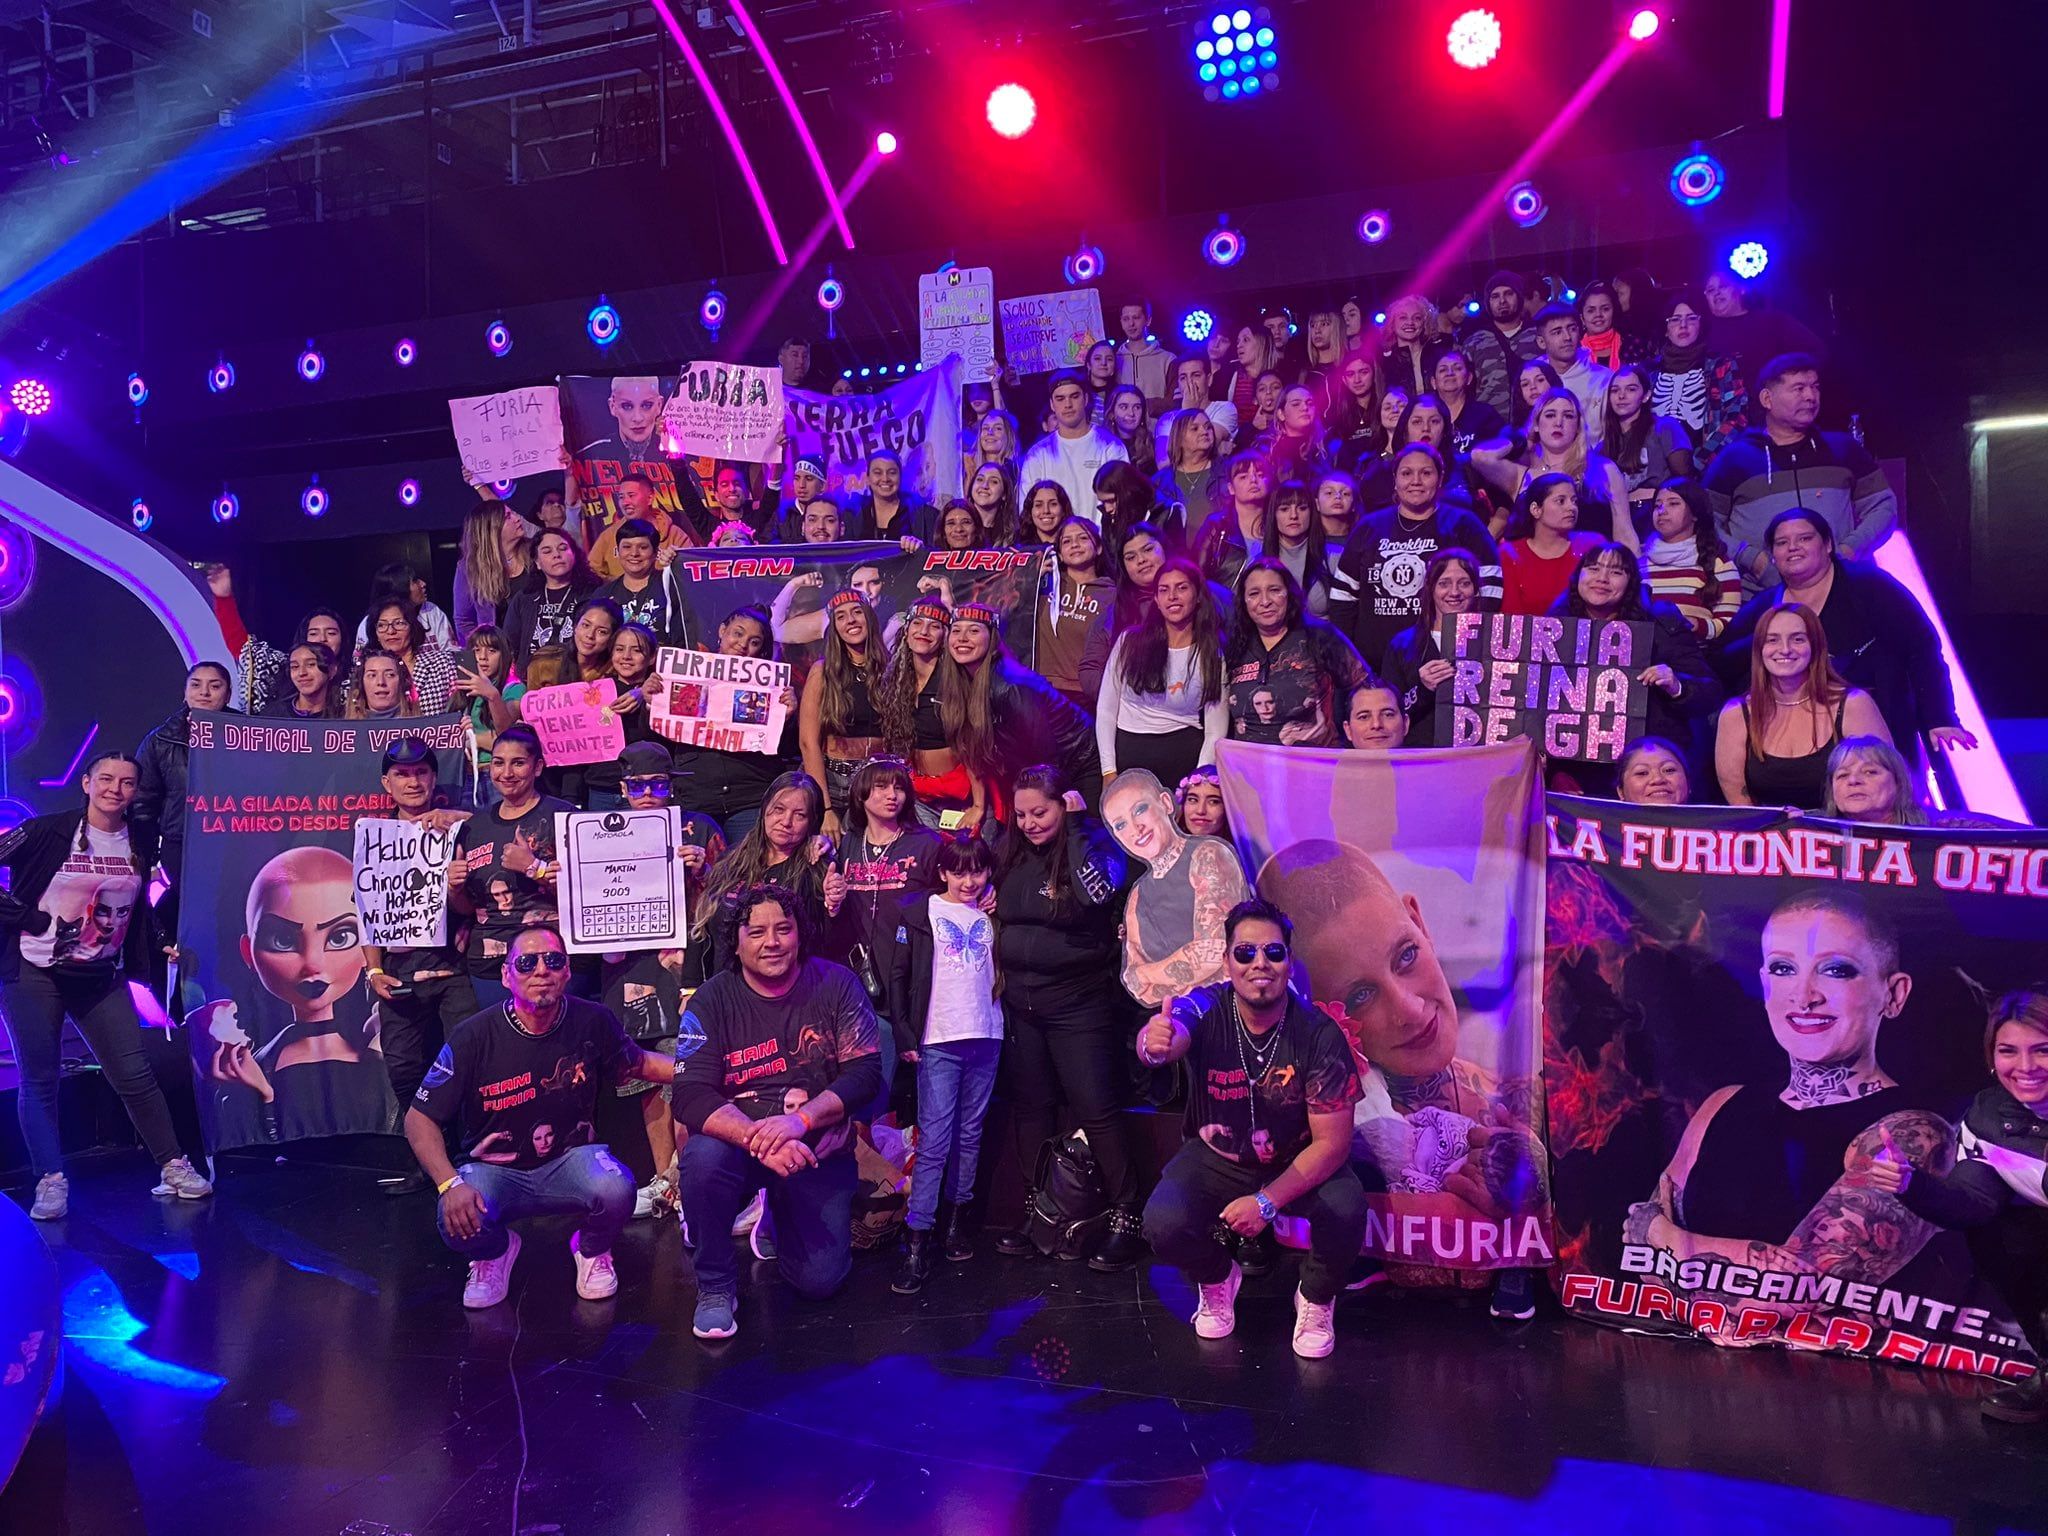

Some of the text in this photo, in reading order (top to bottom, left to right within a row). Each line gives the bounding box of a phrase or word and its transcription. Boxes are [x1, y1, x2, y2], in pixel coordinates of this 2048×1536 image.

[935, 292, 947, 302] LA
[1004, 300, 1045, 319] SOMOS
[672, 363, 768, 407] FURIA
[473, 391, 543, 421] FURIA
[1378, 537, 1438, 553] Brooklyn
[684, 557, 795, 581] TEAM
[1368, 569, 1380, 581] 19
[829, 591, 860, 609] FURIA
[1374, 598, 1421, 608] NEW YO
[917, 604, 949, 622] FURIA
[957, 607, 991, 621] FURIA
[1374, 607, 1408, 616] COLLEGE
[1455, 613, 1633, 667] FURIA
[1453, 660, 1629, 713] REINA
[526, 690, 574, 714] FURIA
[528, 713, 588, 735] TIENE
[1453, 706, 1627, 760] DE GH
[225, 727, 313, 754] DIFICIL
[324, 729, 357, 753] DE
[212, 798, 237, 811] LA
[240, 795, 313, 812] GILADA
[317, 795, 339, 809] NI
[202, 815, 226, 831] LA
[230, 815, 285, 831] MIRO
[289, 814, 350, 830] DESDE
[1546, 815, 2048, 898] LA FURIONETA OFIC
[611, 876, 623, 884] AL
[602, 886, 631, 898] 9009
[479, 1071, 531, 1096] TEAM
[483, 1087, 536, 1111] FURIA
[1561, 1274, 1726, 1339] FURIA
[1784, 1312, 1873, 1351] LA
